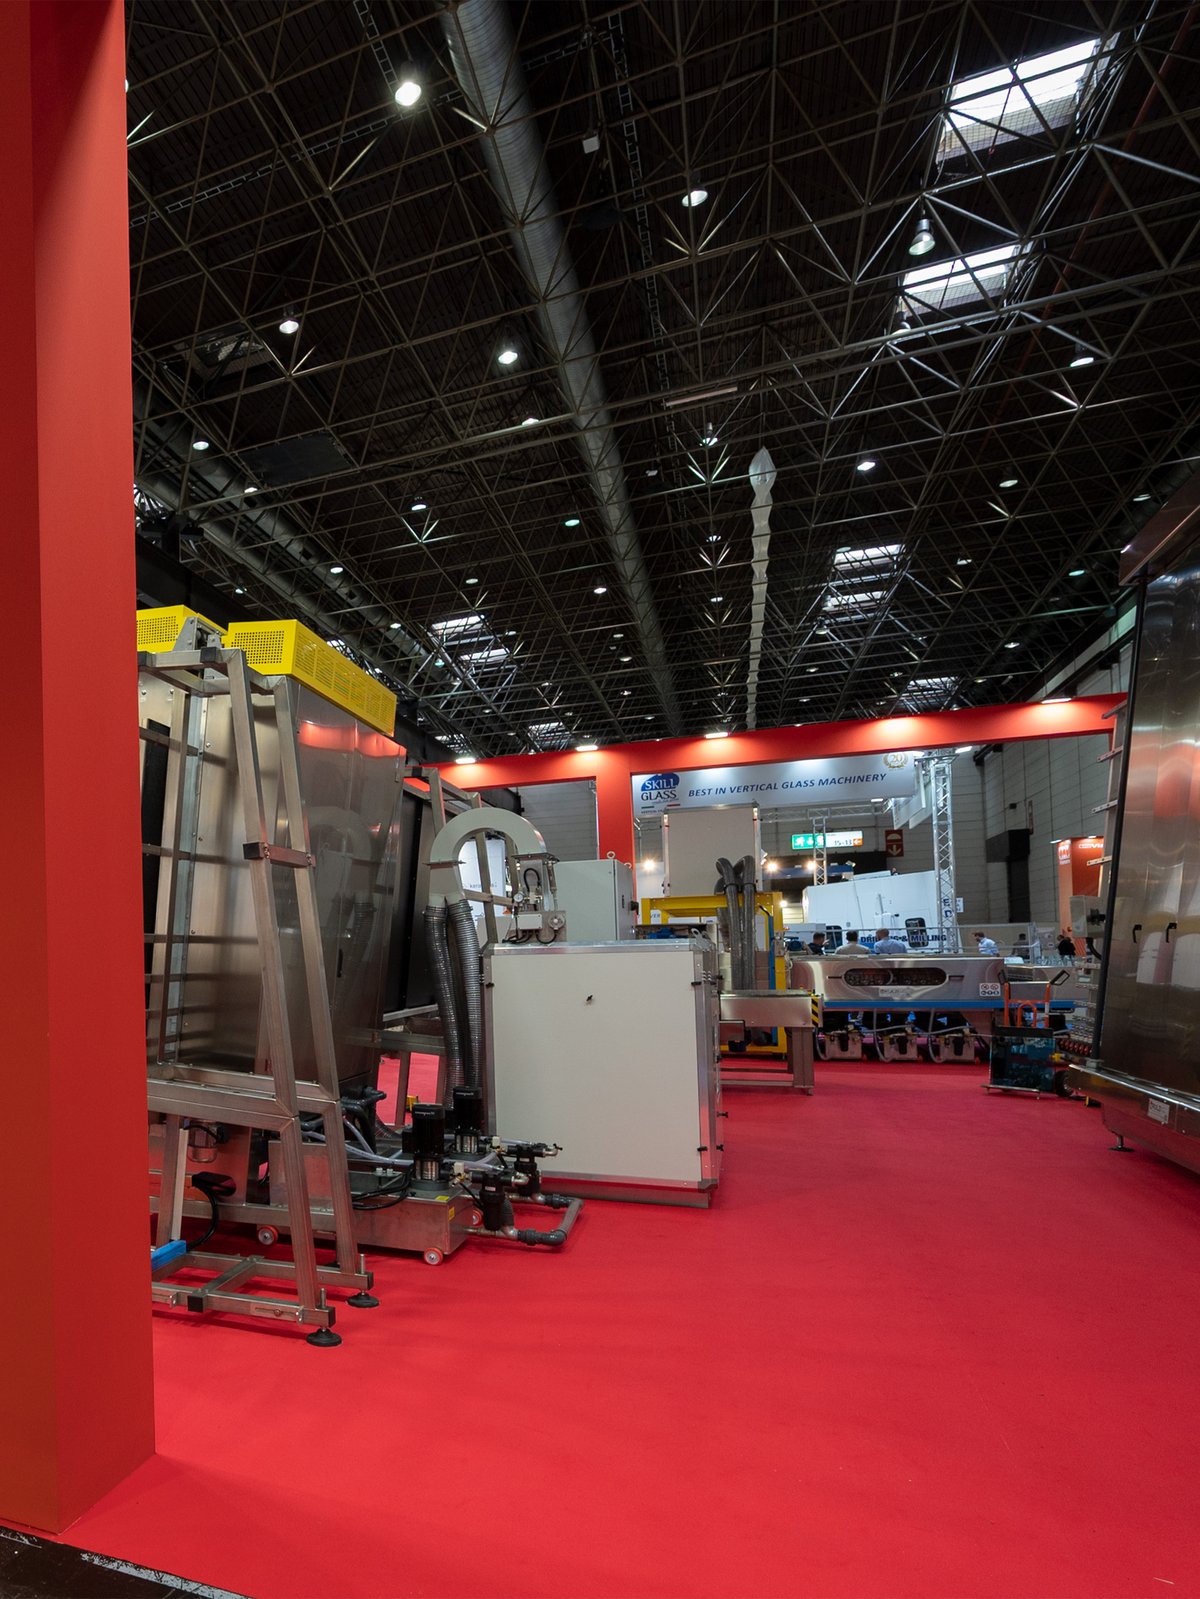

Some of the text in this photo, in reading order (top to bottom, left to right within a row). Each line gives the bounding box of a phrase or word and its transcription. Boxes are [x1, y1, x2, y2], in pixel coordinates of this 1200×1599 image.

[645, 778, 676, 790] SKILL
[688, 773, 887, 797] BEST IN VERTICAL GLASS MACHINERY
[641, 790, 677, 801] GLASS
